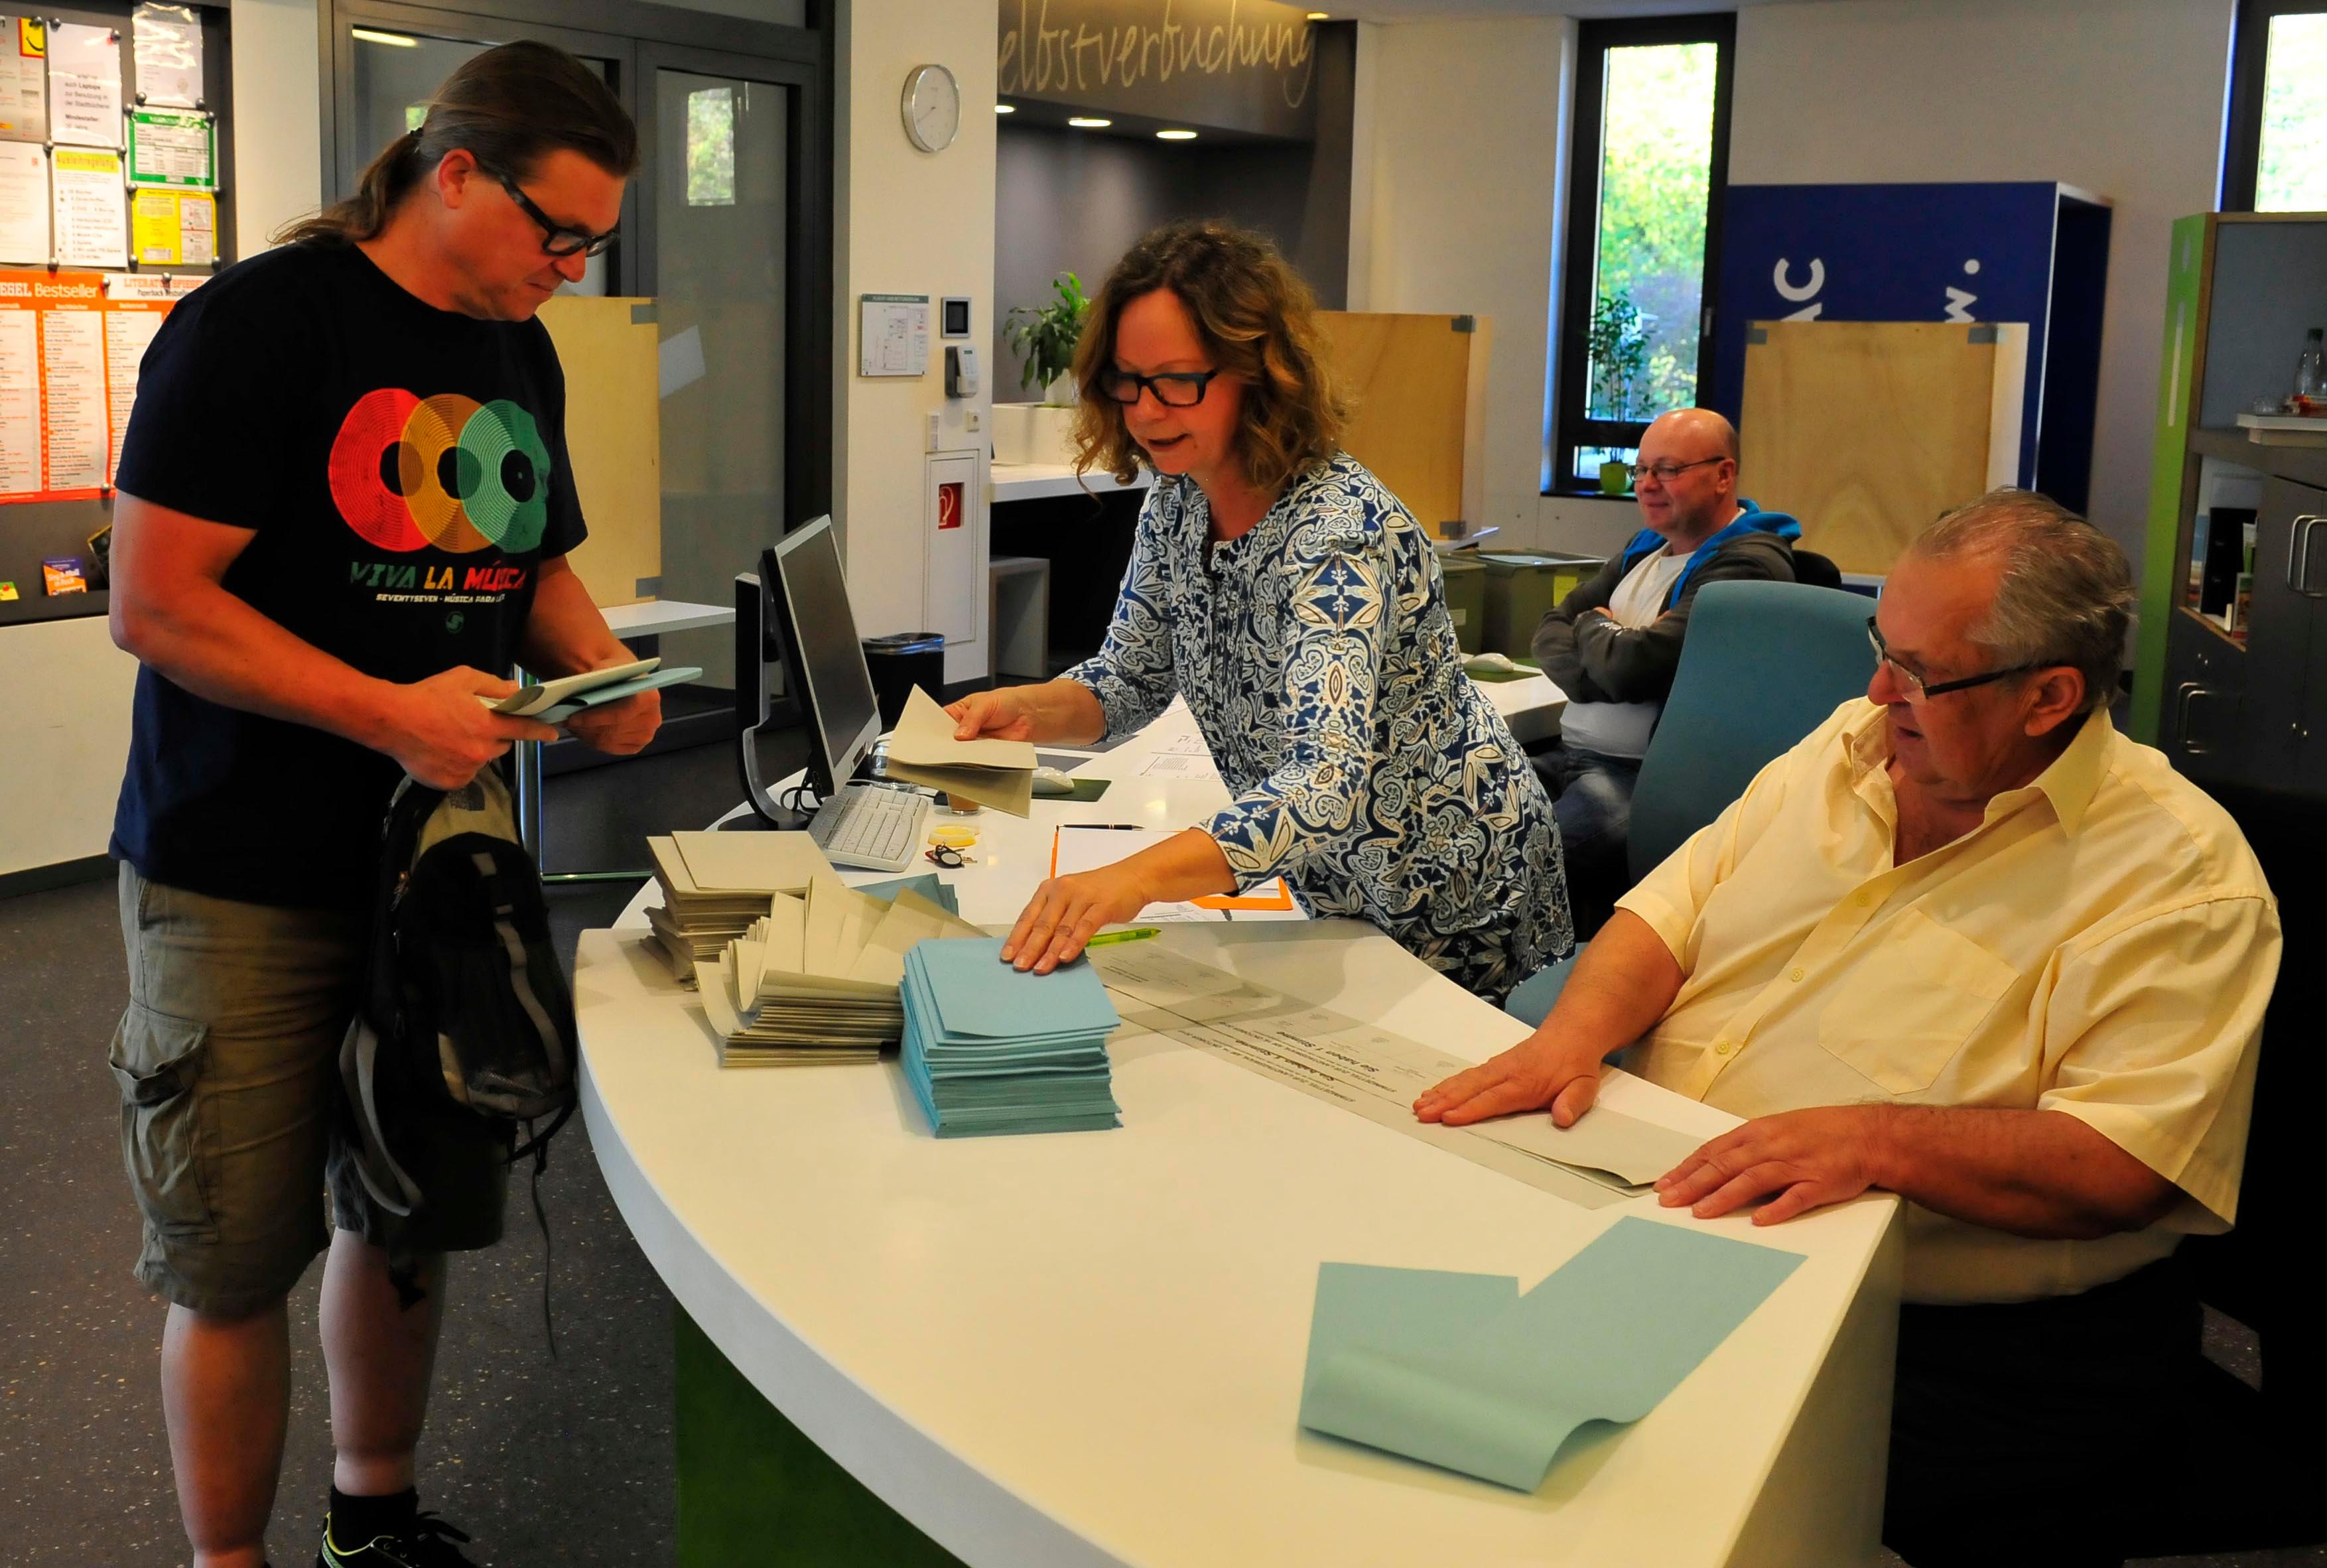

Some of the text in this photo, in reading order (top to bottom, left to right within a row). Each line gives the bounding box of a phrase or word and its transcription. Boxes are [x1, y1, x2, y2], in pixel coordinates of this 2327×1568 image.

[997, 0, 1314, 108] elbstverbuchung
[0, 282, 98, 298] EGEL Bestseller
[350, 561, 417, 589] VIVA
[423, 566, 454, 590] LA
[1275, 1030, 1317, 1048] Stimme
[1324, 1050, 1361, 1066] haben
